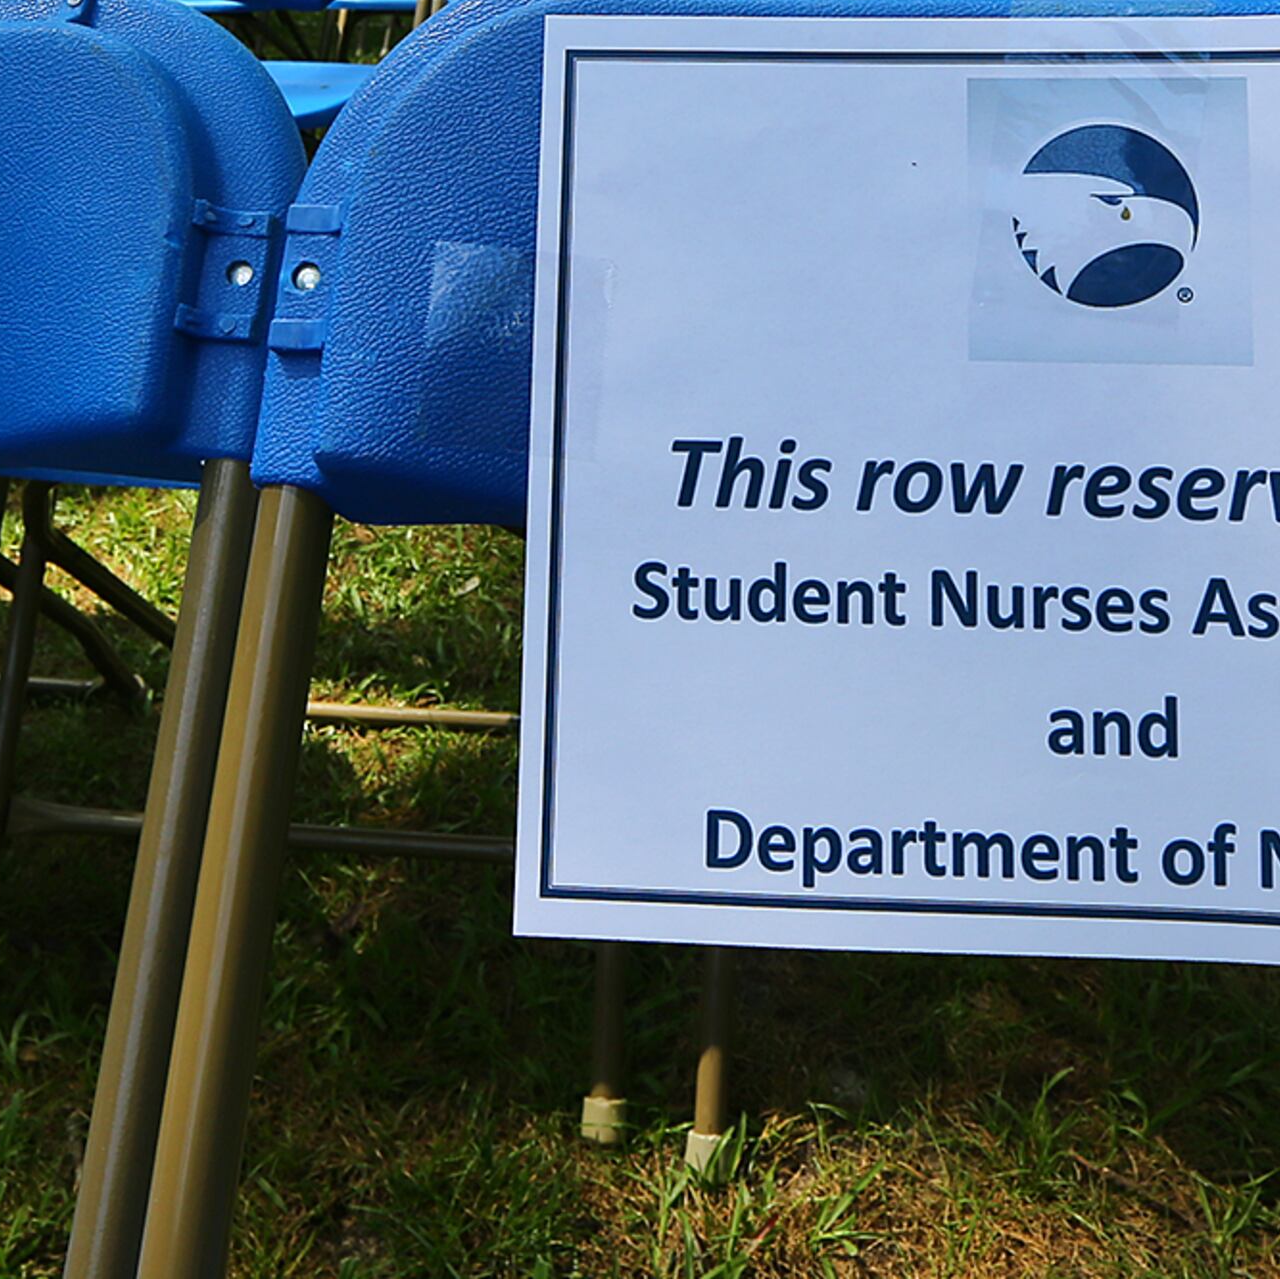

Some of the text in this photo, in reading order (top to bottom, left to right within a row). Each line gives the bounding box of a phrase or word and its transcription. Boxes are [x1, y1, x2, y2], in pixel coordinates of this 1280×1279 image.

[670, 435, 833, 512] This
[855, 459, 1026, 516] row
[631, 560, 907, 628] Student
[930, 568, 1172, 635] Nurses
[1047, 694, 1180, 759] and
[705, 808, 1140, 890] Department
[1160, 821, 1238, 888] of
